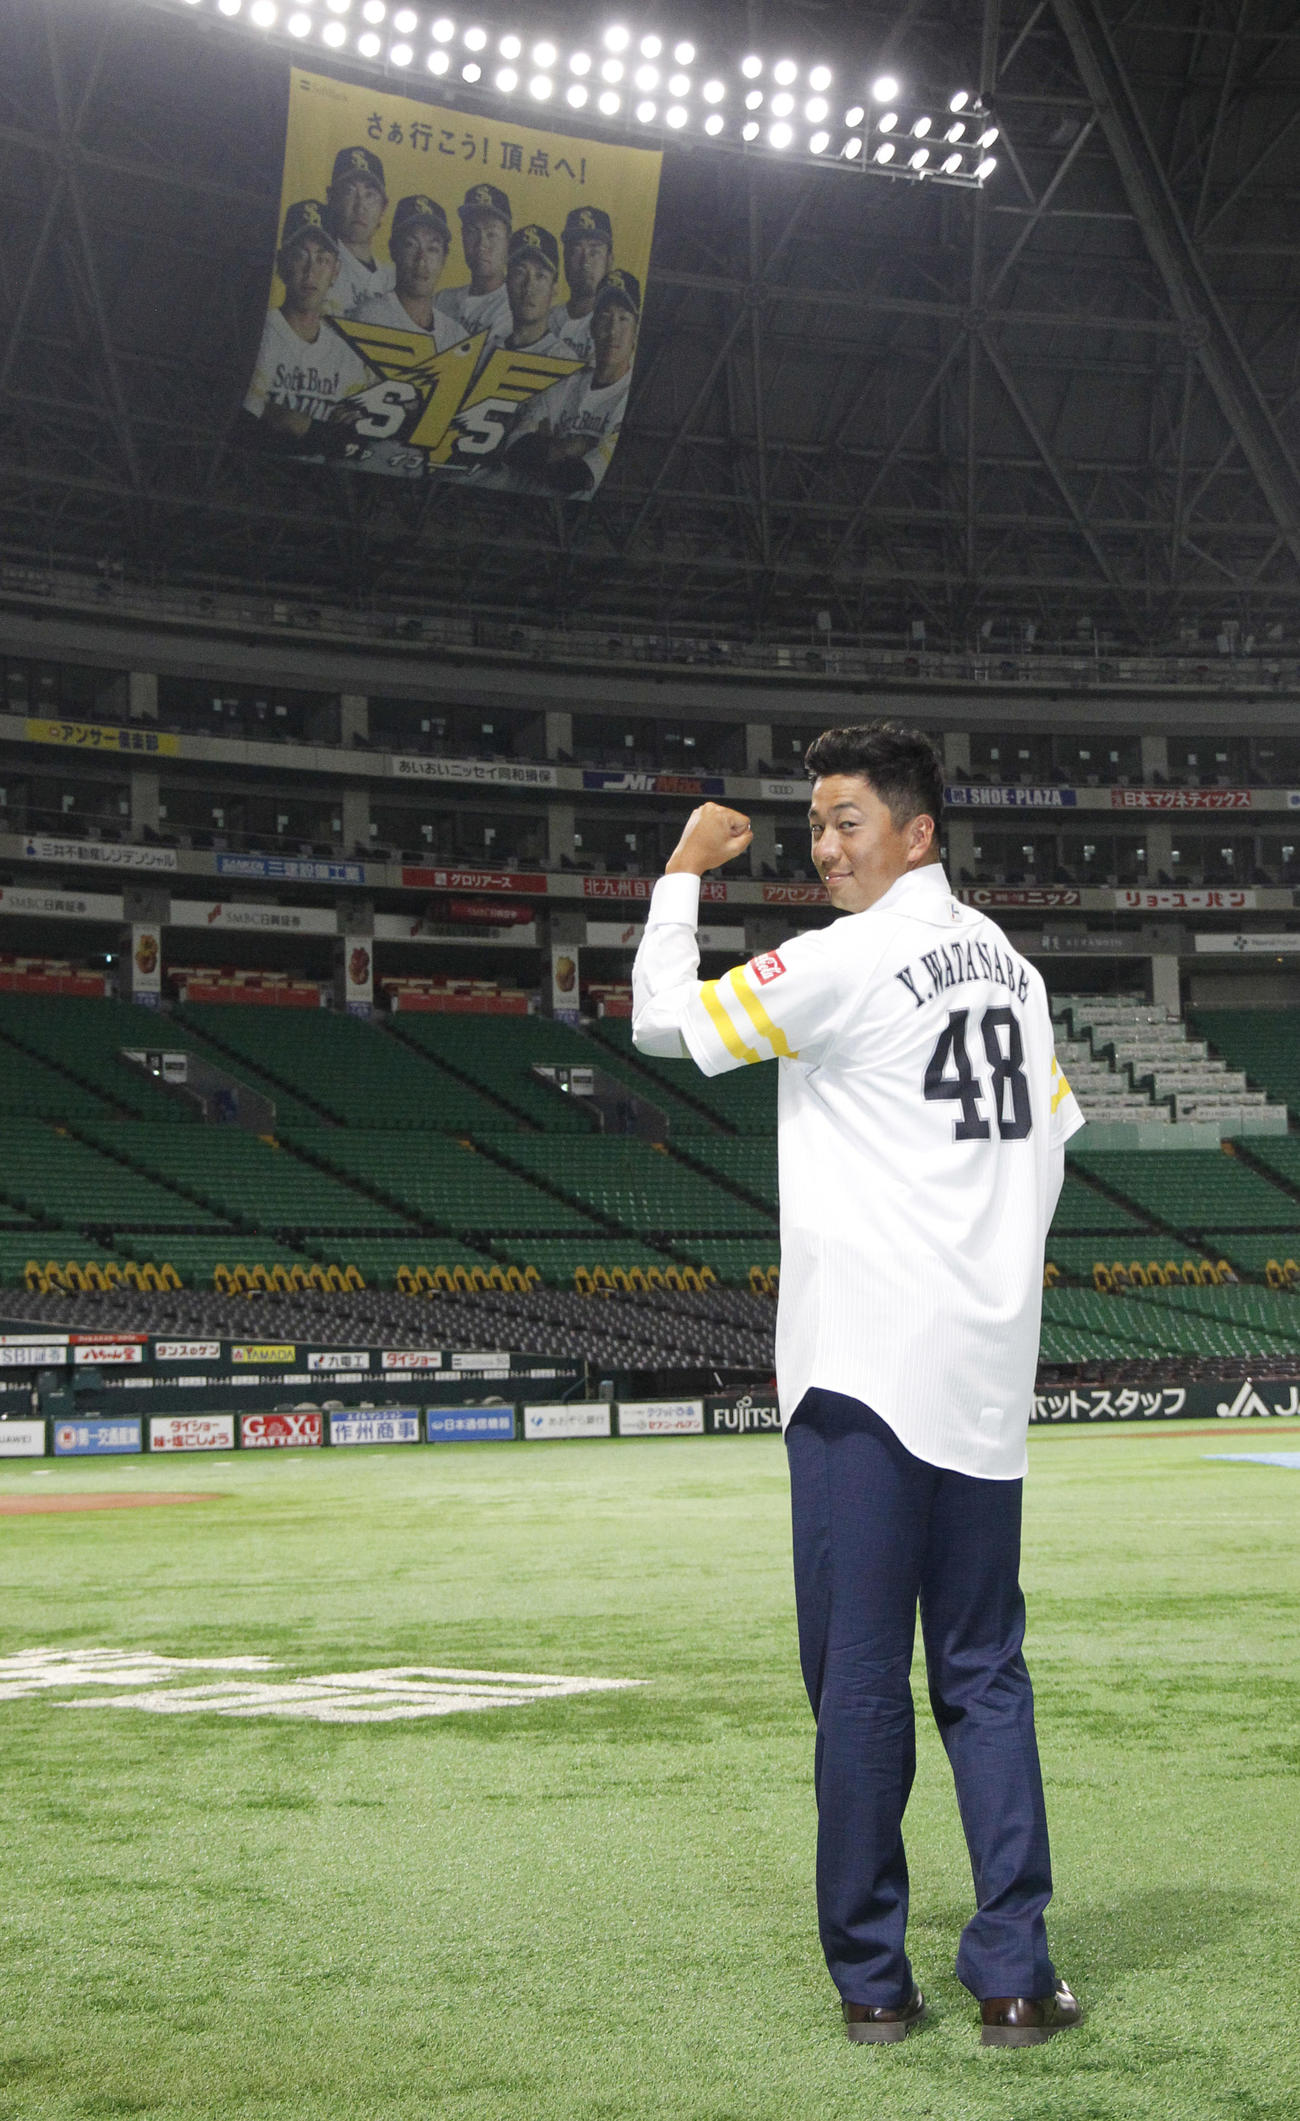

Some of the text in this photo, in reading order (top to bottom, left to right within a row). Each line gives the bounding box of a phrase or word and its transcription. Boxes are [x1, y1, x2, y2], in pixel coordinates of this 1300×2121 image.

[500, 141, 587, 185] 頂点へ！
[399, 760, 552, 782] あいおいニッセイ同和損保
[1124, 791, 1250, 808] 日本マグネティックス
[765, 886, 831, 902] アクセンチュ
[1126, 891, 1245, 908] リョーユーパン
[923, 1004, 1034, 1143] 48
[245, 1347, 294, 1361] YAMADA
[328, 1355, 363, 1367] 九電工
[387, 1352, 438, 1366] ダイショー
[170, 1420, 220, 1432] ダイショー
[335, 1421, 416, 1442] 作州商事
